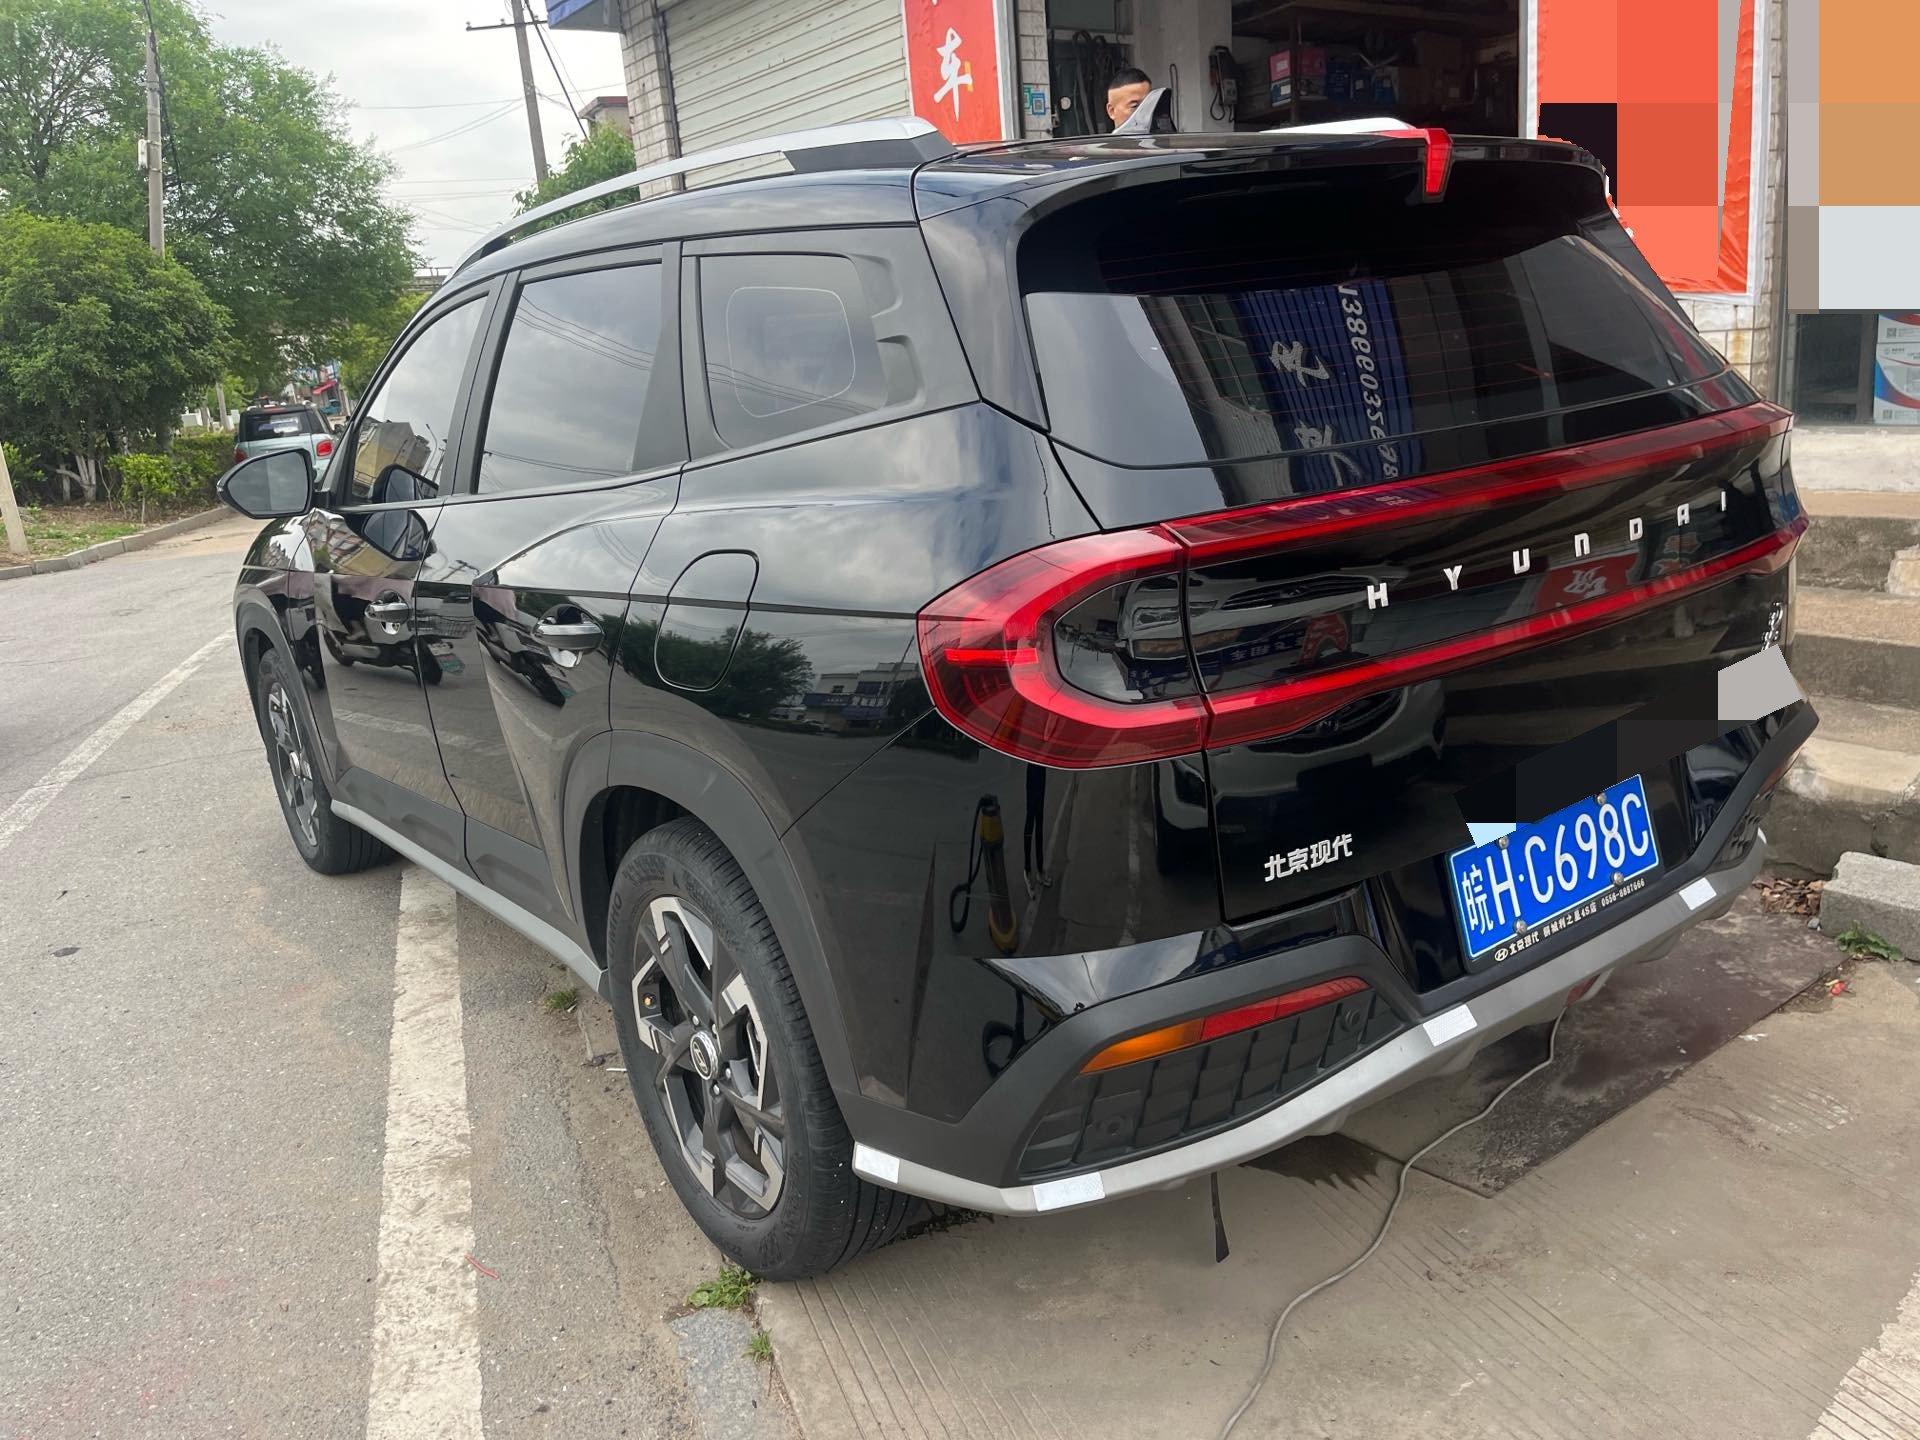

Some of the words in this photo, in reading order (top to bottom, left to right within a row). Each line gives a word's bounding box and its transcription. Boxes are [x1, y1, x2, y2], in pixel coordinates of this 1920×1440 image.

[1367, 491, 1727, 610] HYUNDAI
[1264, 833, 1353, 882] 北京现代
[1461, 793, 1649, 935] 皖H·C698C
